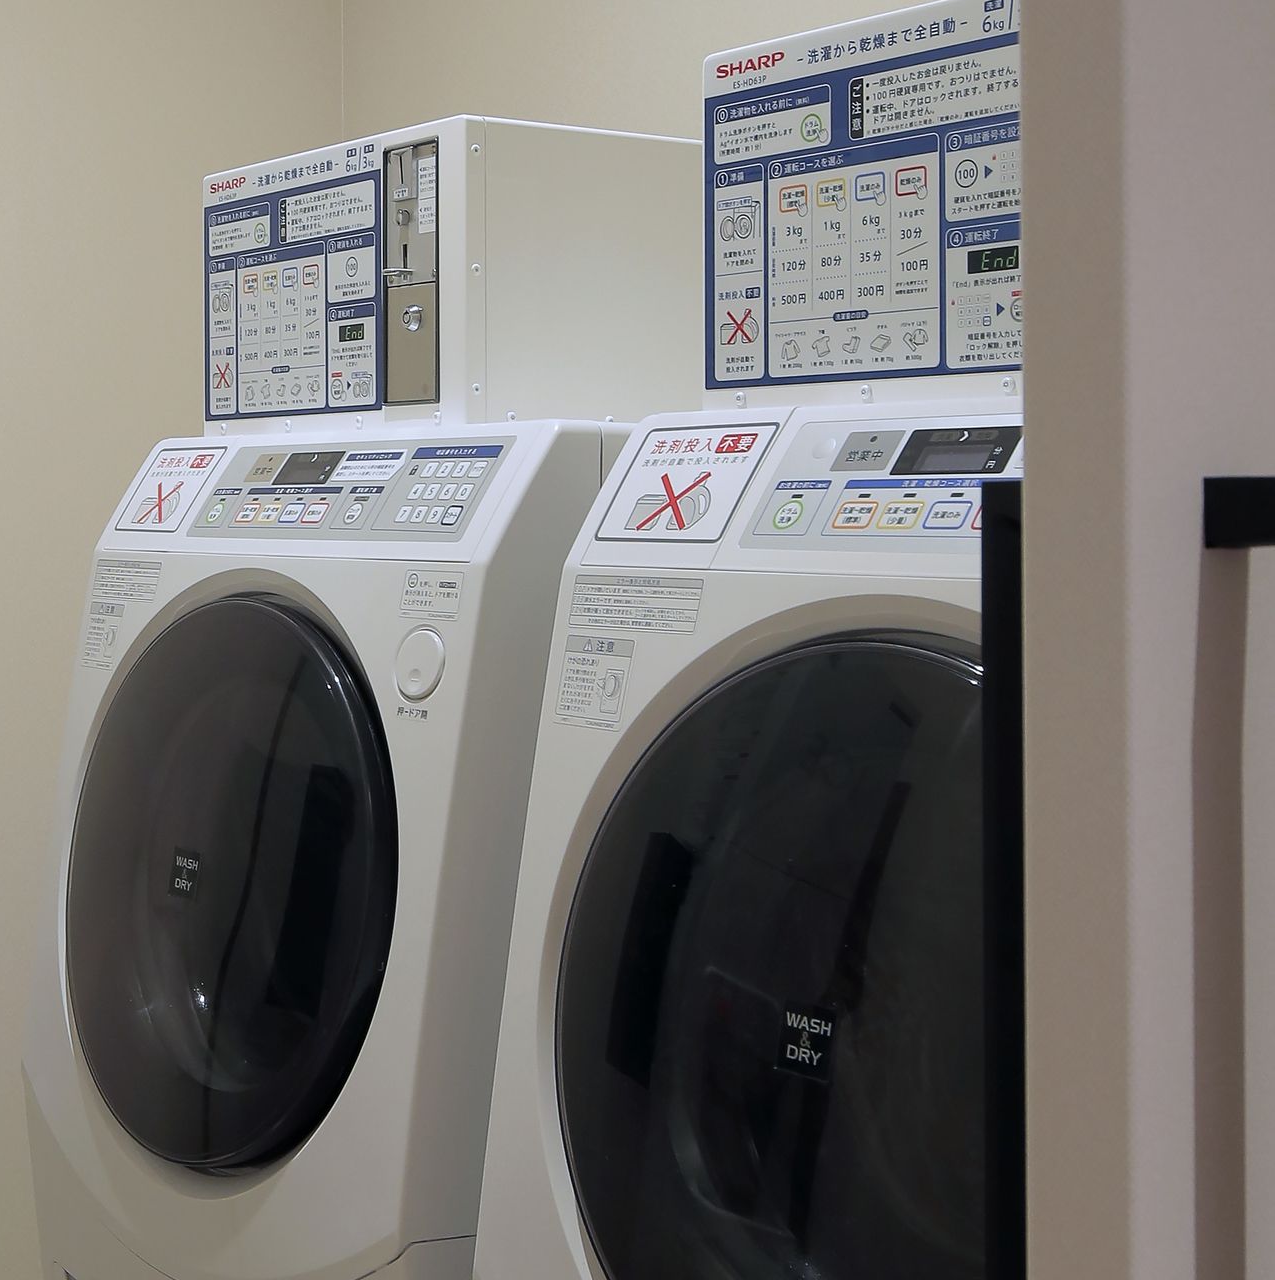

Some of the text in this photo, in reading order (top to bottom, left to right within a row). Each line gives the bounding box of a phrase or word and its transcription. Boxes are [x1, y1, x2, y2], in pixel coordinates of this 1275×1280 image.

[982, 15, 1005, 33] 6kg
[716, 51, 785, 79] SHARP
[872, 60, 982, 87] 一度投入したお金は戻りません。
[733, 74, 767, 90] ES-HD63P
[730, 98, 793, 118] 洗濯物を入れる前に
[873, 107, 935, 125] ドアは開きません。
[784, 155, 844, 174] 運転コースを選ぶ
[958, 168, 975, 180] 100
[209, 176, 246, 194] SHARP
[824, 221, 841, 232] 1kg
[862, 215, 880, 227] 6kg
[786, 226, 803, 238] 3kg
[900, 227, 922, 240] 30分
[965, 228, 999, 243] 運転終了
[821, 256, 842, 268] 80分
[860, 250, 882, 263] 35分
[981, 248, 1017, 271] End
[781, 259, 806, 272] 120分
[900, 259, 929, 272] 100円
[818, 289, 845, 301] 400円
[857, 285, 885, 298] 300円
[781, 293, 807, 306] 500円
[345, 326, 363, 341] End
[650, 438, 713, 455] 洗剤投入
[720, 435, 754, 452] 不要
[642, 455, 749, 468] 洗剤が自動で投入されます
[845, 449, 884, 462] 営業中
[427, 465, 433, 474] 1
[441, 465, 448, 473] 2
[456, 465, 464, 473] 3
[985, 460, 996, 469] 円
[412, 487, 419, 496] 4
[427, 487, 435, 496] 5
[444, 487, 451, 496] 6
[460, 487, 468, 496] 0
[400, 509, 407, 518] 7
[415, 509, 422, 519] 8
[431, 509, 438, 519] 9
[778, 516, 792, 524] 洗浄
[931, 511, 961, 519] 洗濯のみ
[596, 640, 614, 653] 注意
[176, 855, 199, 871] WASH
[174, 877, 193, 891] DRY
[786, 1011, 832, 1037] WASH
[800, 1031, 811, 1049] &
[786, 1044, 823, 1066] DRY
